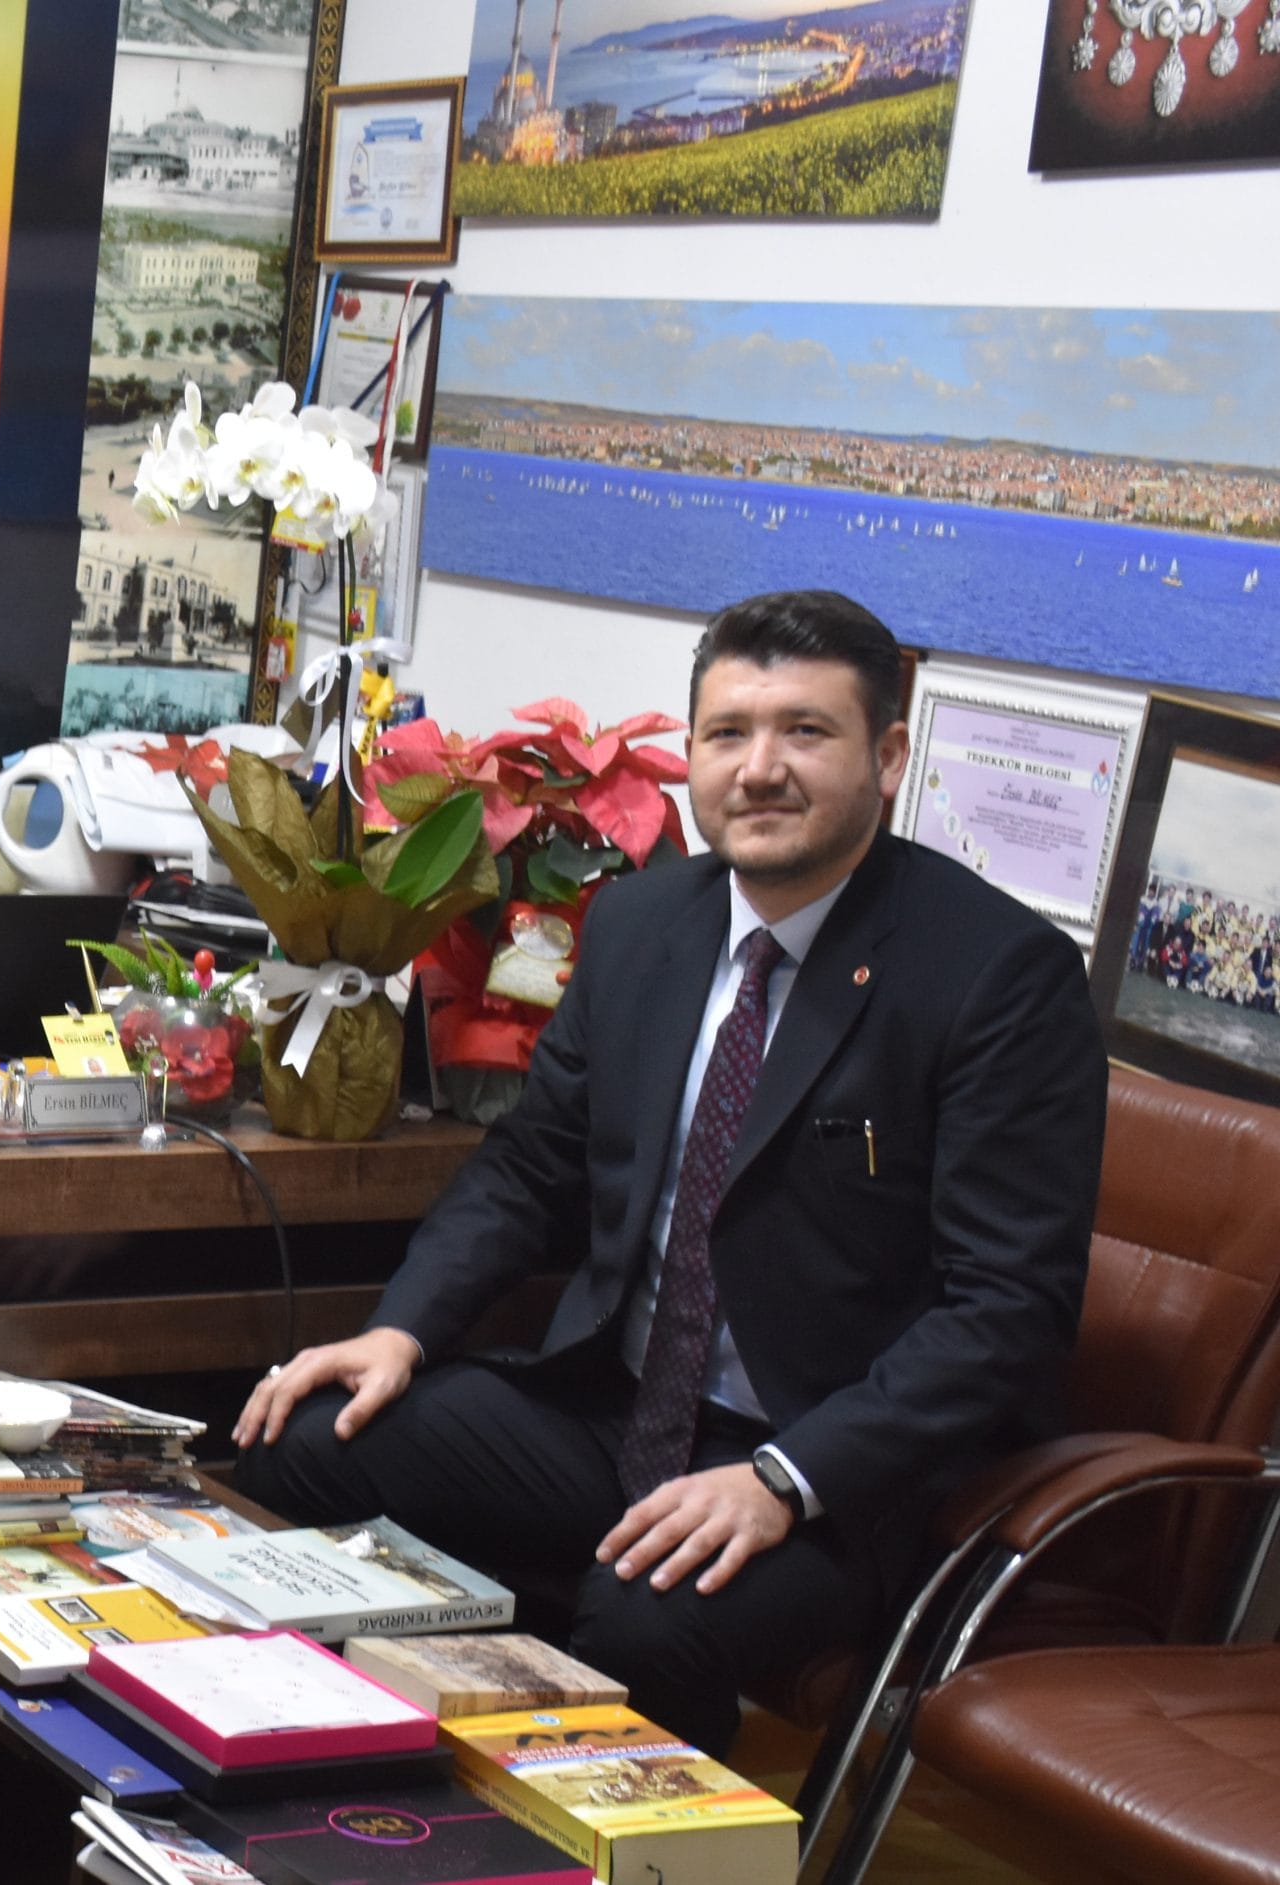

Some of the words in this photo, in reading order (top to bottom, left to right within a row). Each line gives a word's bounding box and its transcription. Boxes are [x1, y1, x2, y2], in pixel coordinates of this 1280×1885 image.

[966, 750, 1021, 771] TEŞEKKÜR
[1025, 763, 1071, 782] BELGESİ
[44, 1094, 76, 1112] Ersin
[79, 1090, 128, 1112] BİLMEÇ
[357, 1610, 433, 1632] TEKİRDAĞ
[439, 1602, 504, 1623] SEVDAM
